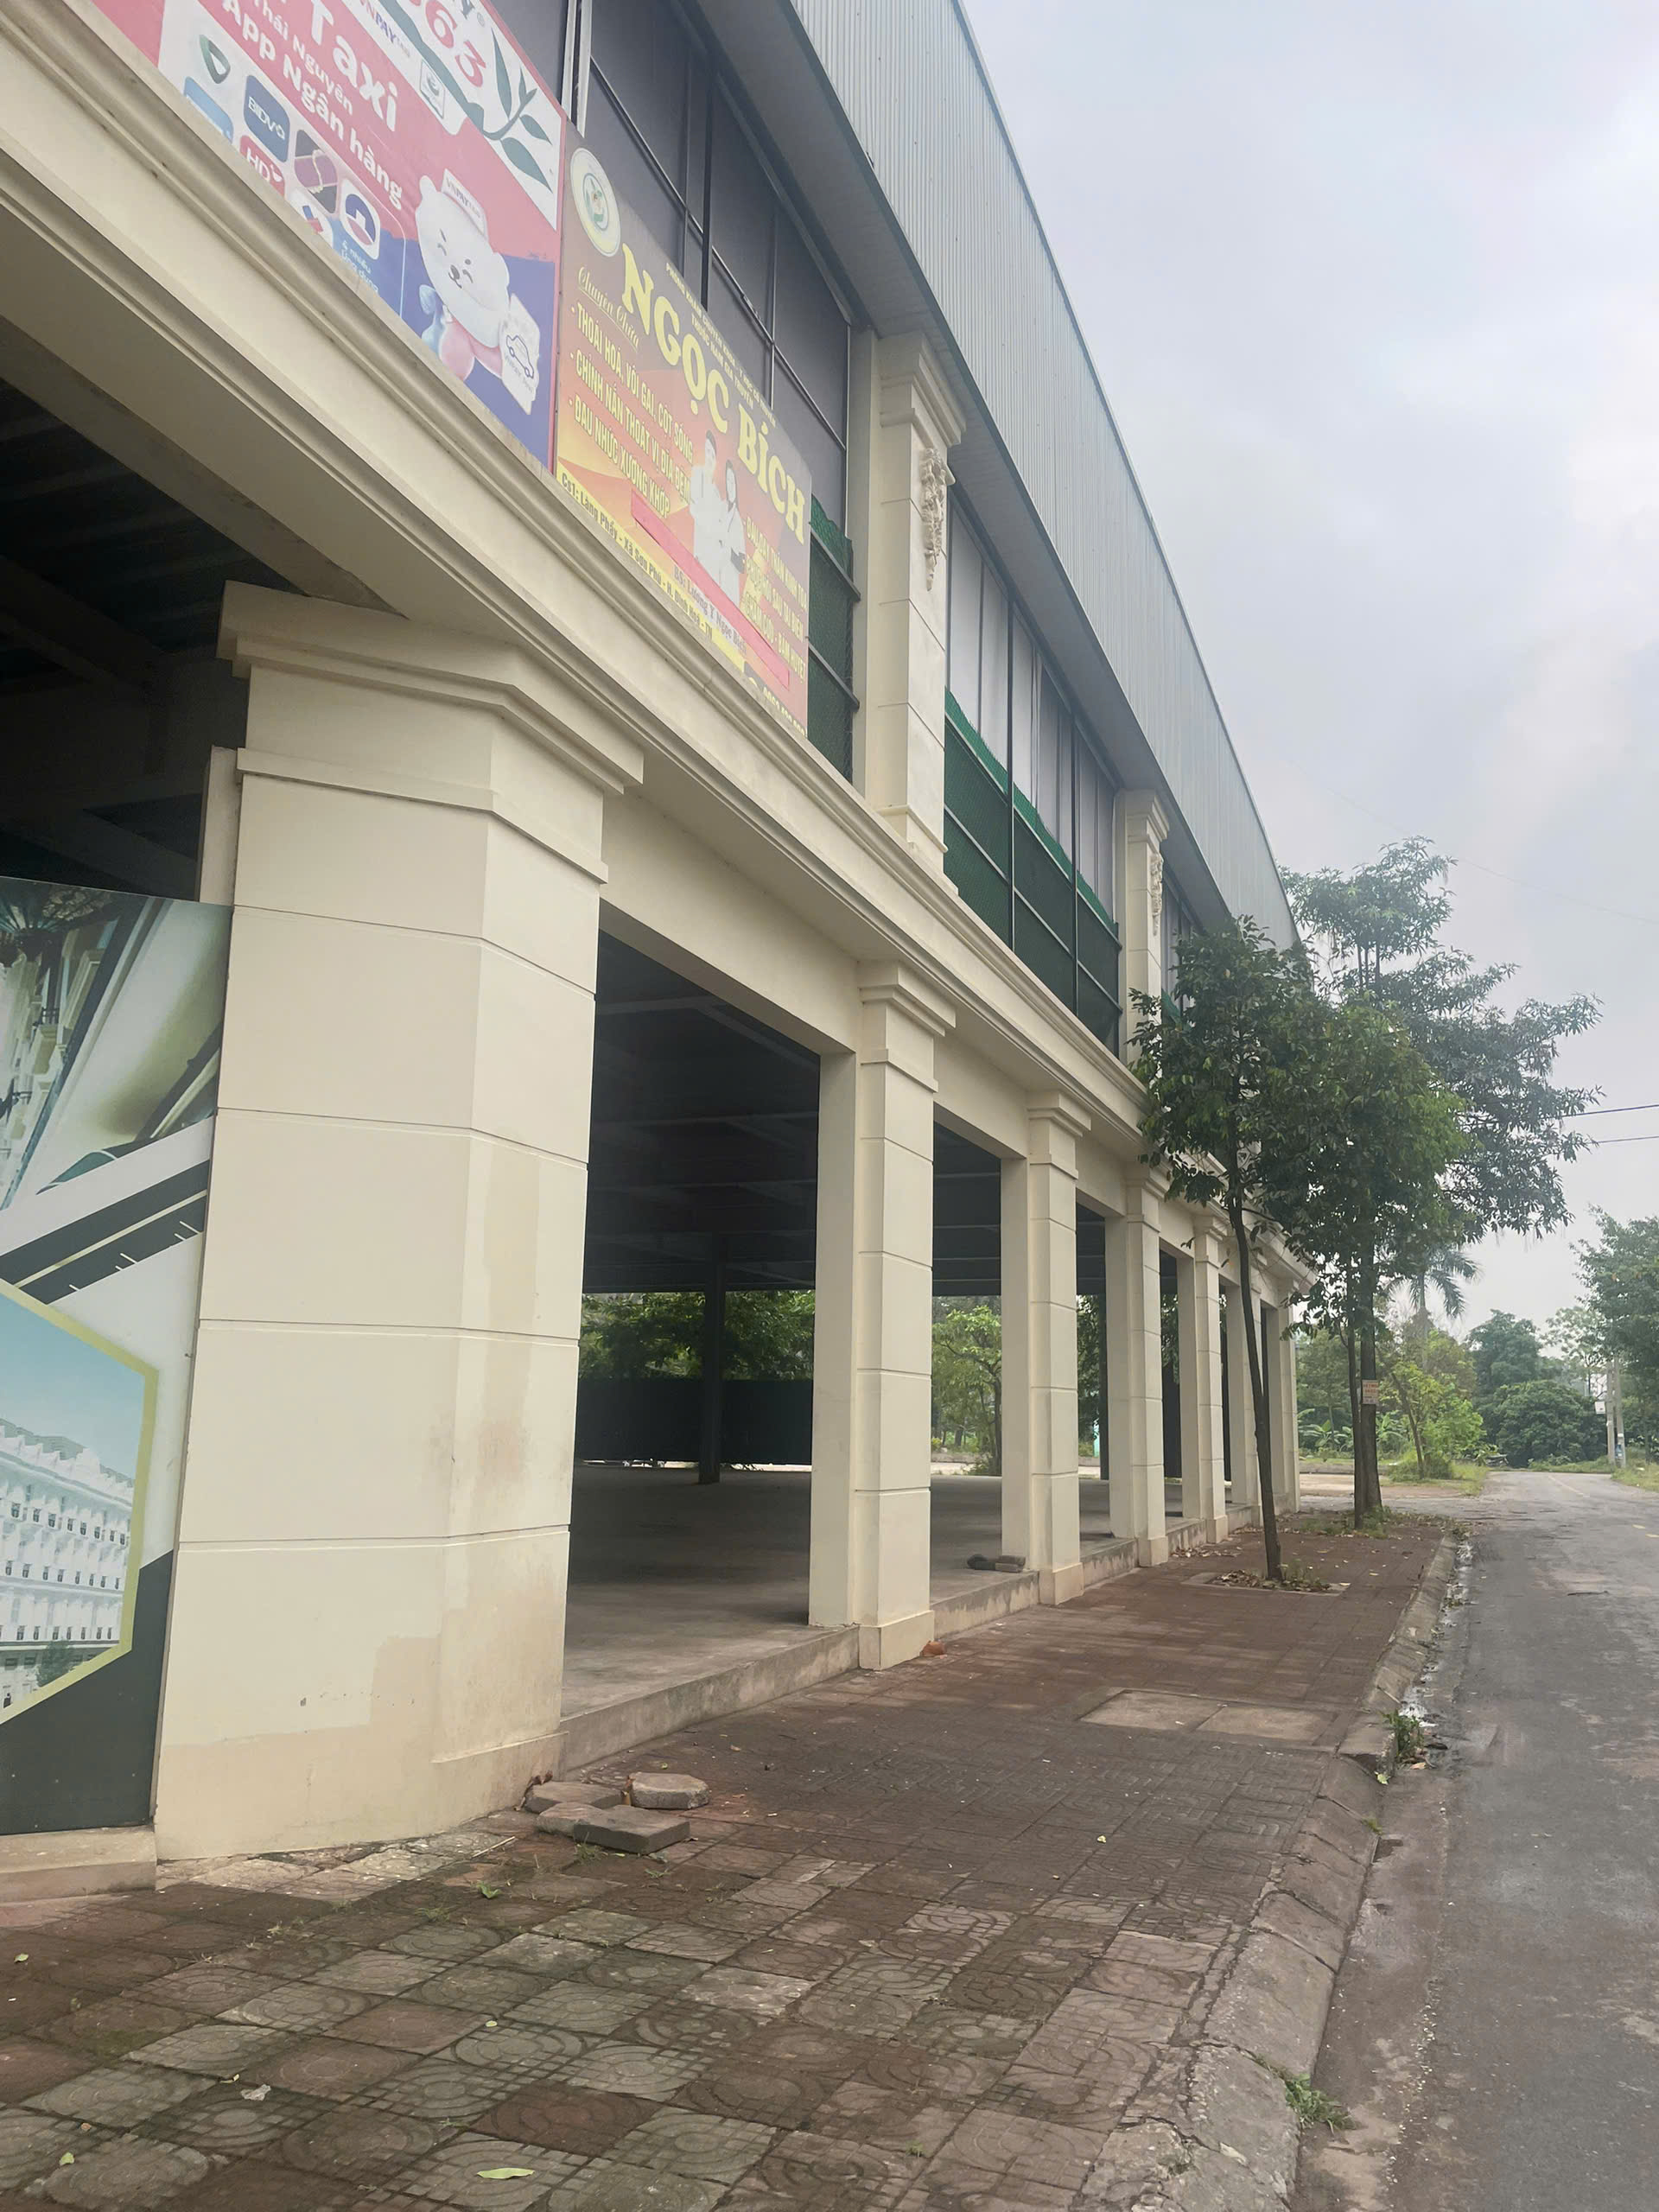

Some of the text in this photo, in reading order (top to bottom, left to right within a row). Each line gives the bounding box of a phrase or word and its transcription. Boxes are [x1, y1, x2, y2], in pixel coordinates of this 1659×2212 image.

[221, 0, 403, 212] App Ngân hàng
[291, 34, 353, 116] Nguyên
[311, 0, 398, 132] Taxi
[247, 96, 276, 132] BIDV
[577, 302, 604, 355] THOÁI
[578, 265, 613, 316] Chuyên
[576, 349, 604, 404] CHỈNH
[625, 405, 651, 457] THOÁT
[621, 242, 805, 546] NGỌC BÍCH
[574, 394, 671, 520] ĐAU NHỨC XƯƠNG KHỚP
[562, 472, 579, 501] Cs1:
[580, 488, 599, 521] Làng
[624, 537, 633, 556] Xã
[674, 565, 686, 588] BS:
